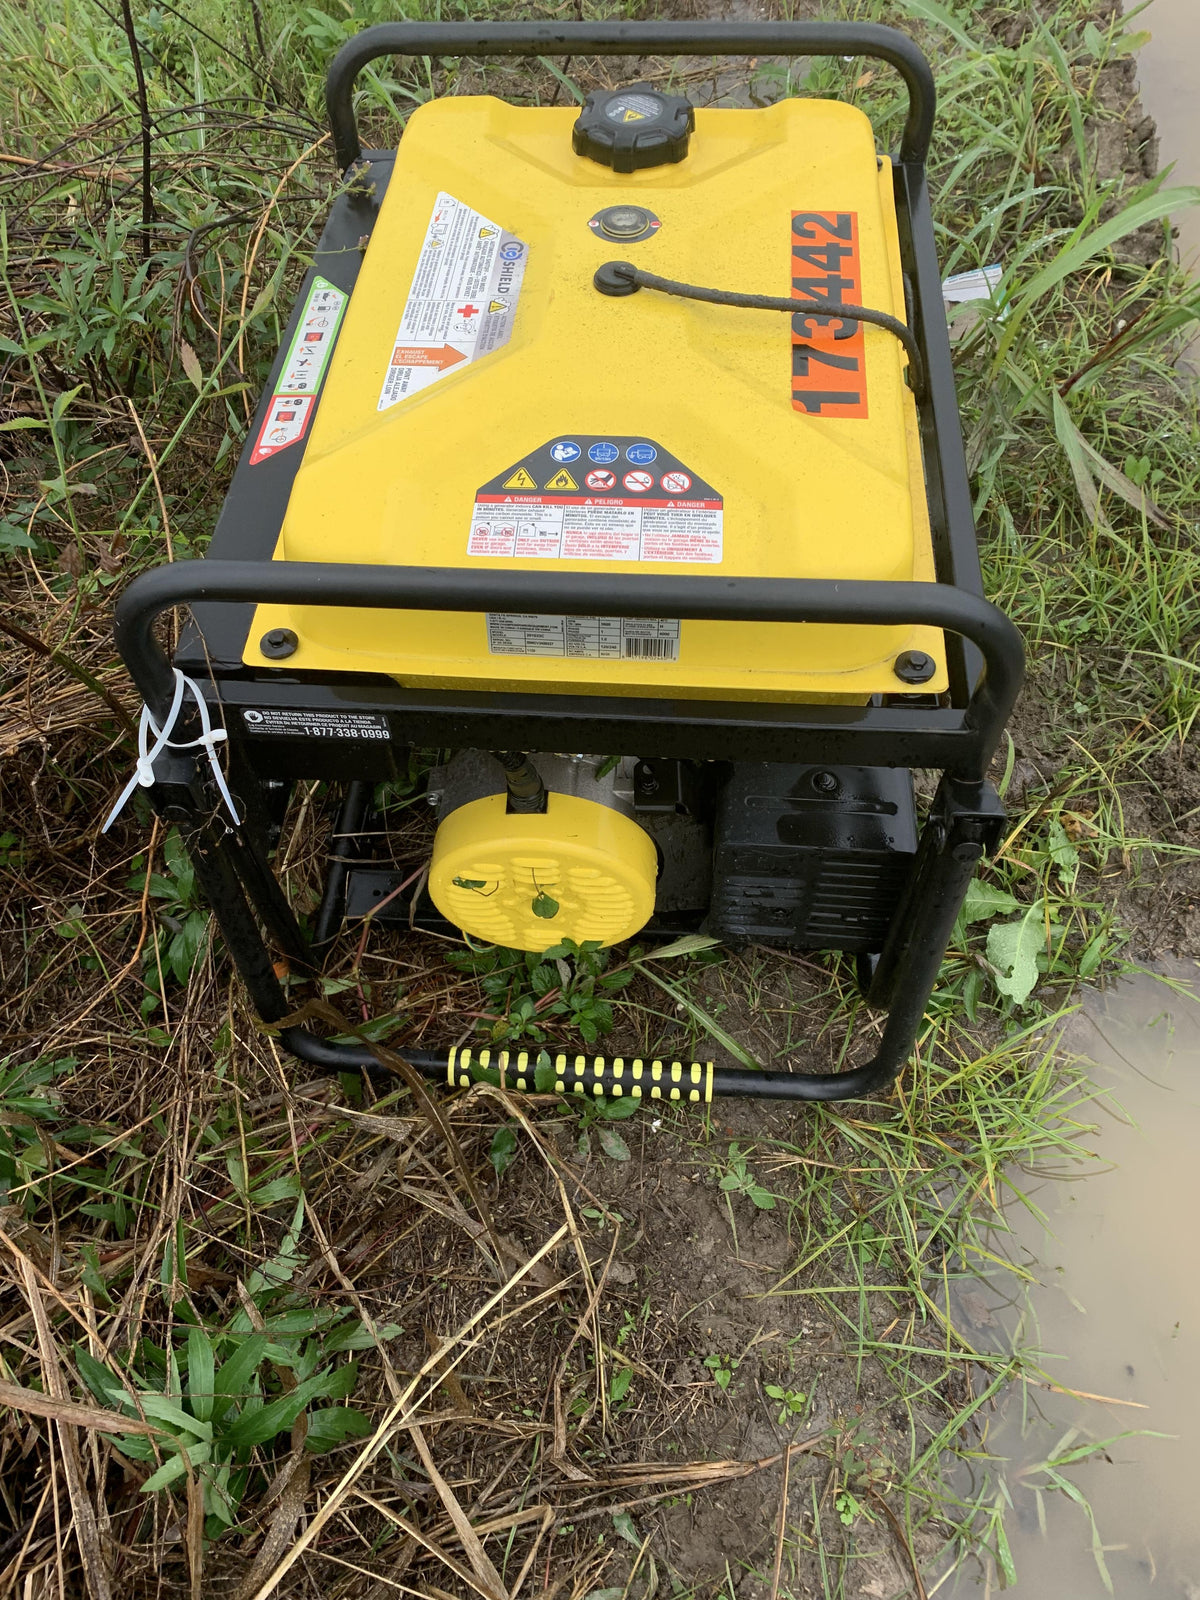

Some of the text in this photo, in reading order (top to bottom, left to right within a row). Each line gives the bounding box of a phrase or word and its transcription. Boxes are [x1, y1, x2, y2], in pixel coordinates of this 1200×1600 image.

[498, 262, 515, 293] SHIELD
[792, 213, 860, 413] 173442
[304, 727, 390, 739] 1-877-338-0999
